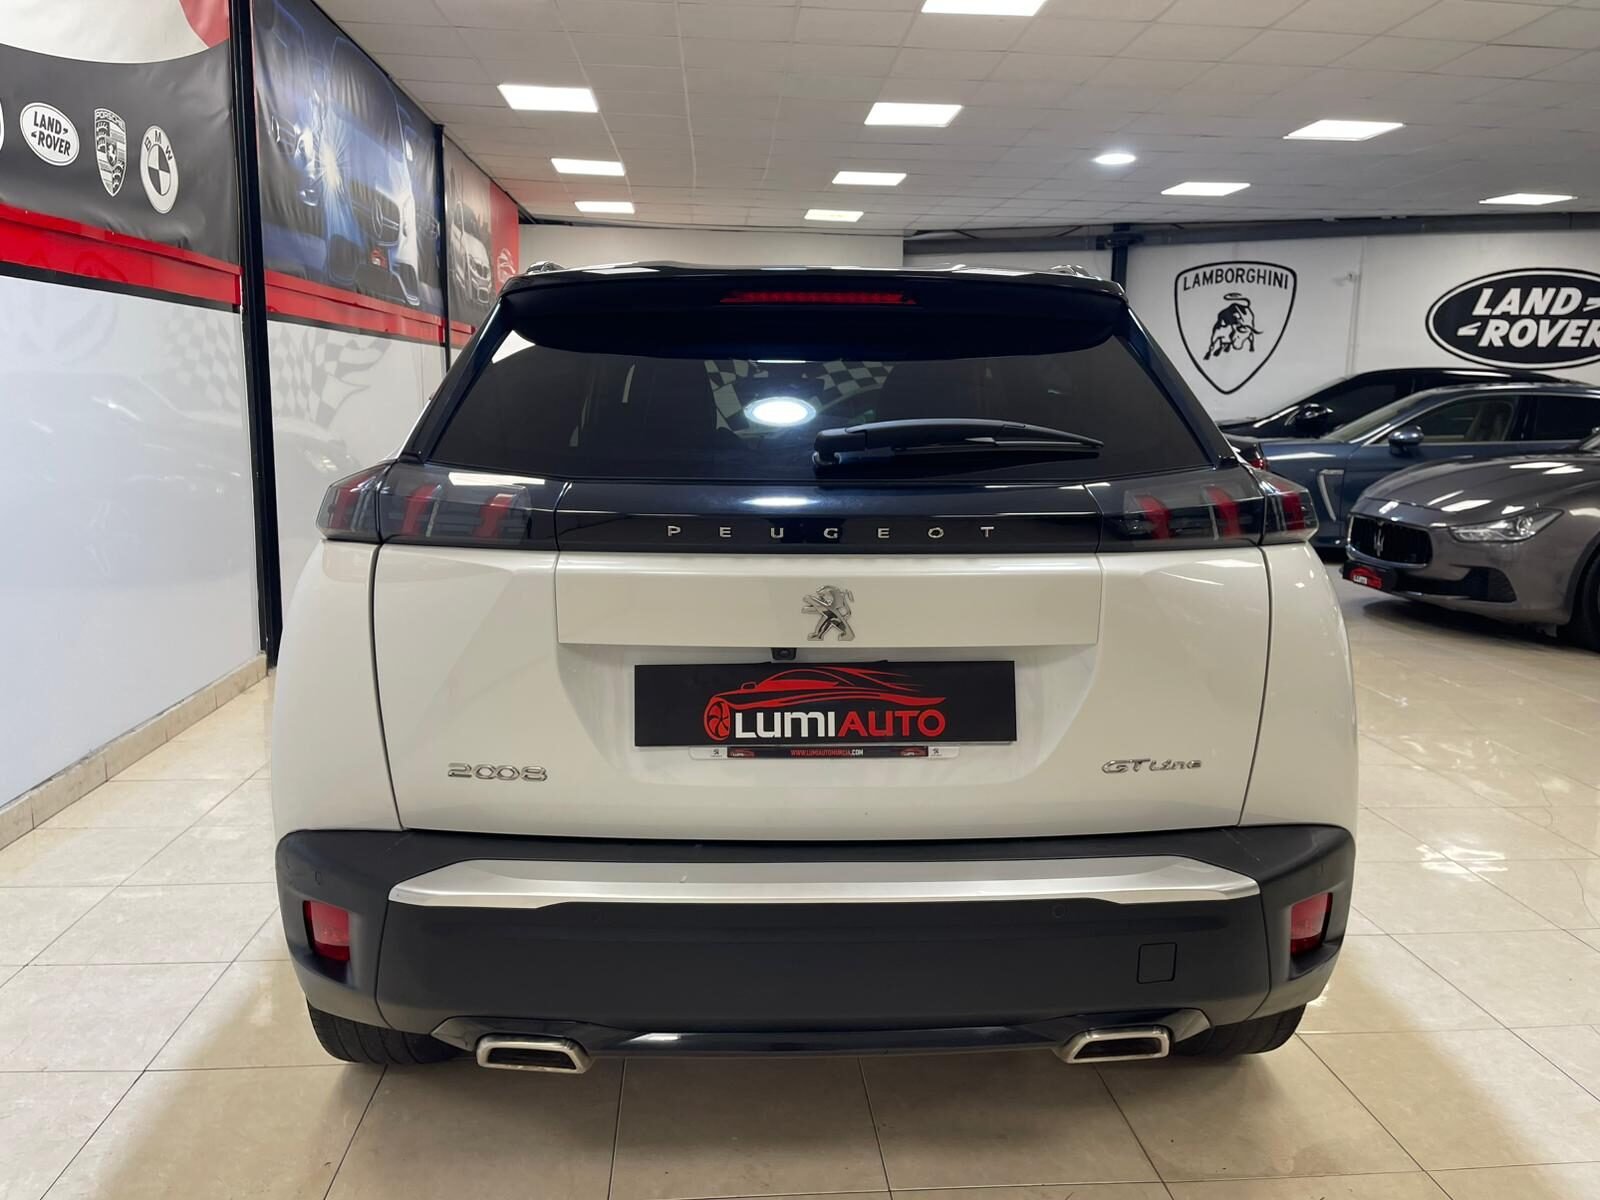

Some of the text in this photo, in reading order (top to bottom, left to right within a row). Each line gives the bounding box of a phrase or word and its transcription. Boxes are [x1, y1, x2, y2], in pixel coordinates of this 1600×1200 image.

[33, 111, 66, 134] LAND
[38, 134, 71, 156] ROVER
[1183, 267, 1289, 291] LAMBORGHINI
[1472, 287, 1583, 316] LAND
[666, 525, 996, 540] PEUGEOT
[447, 762, 548, 782] 2008
